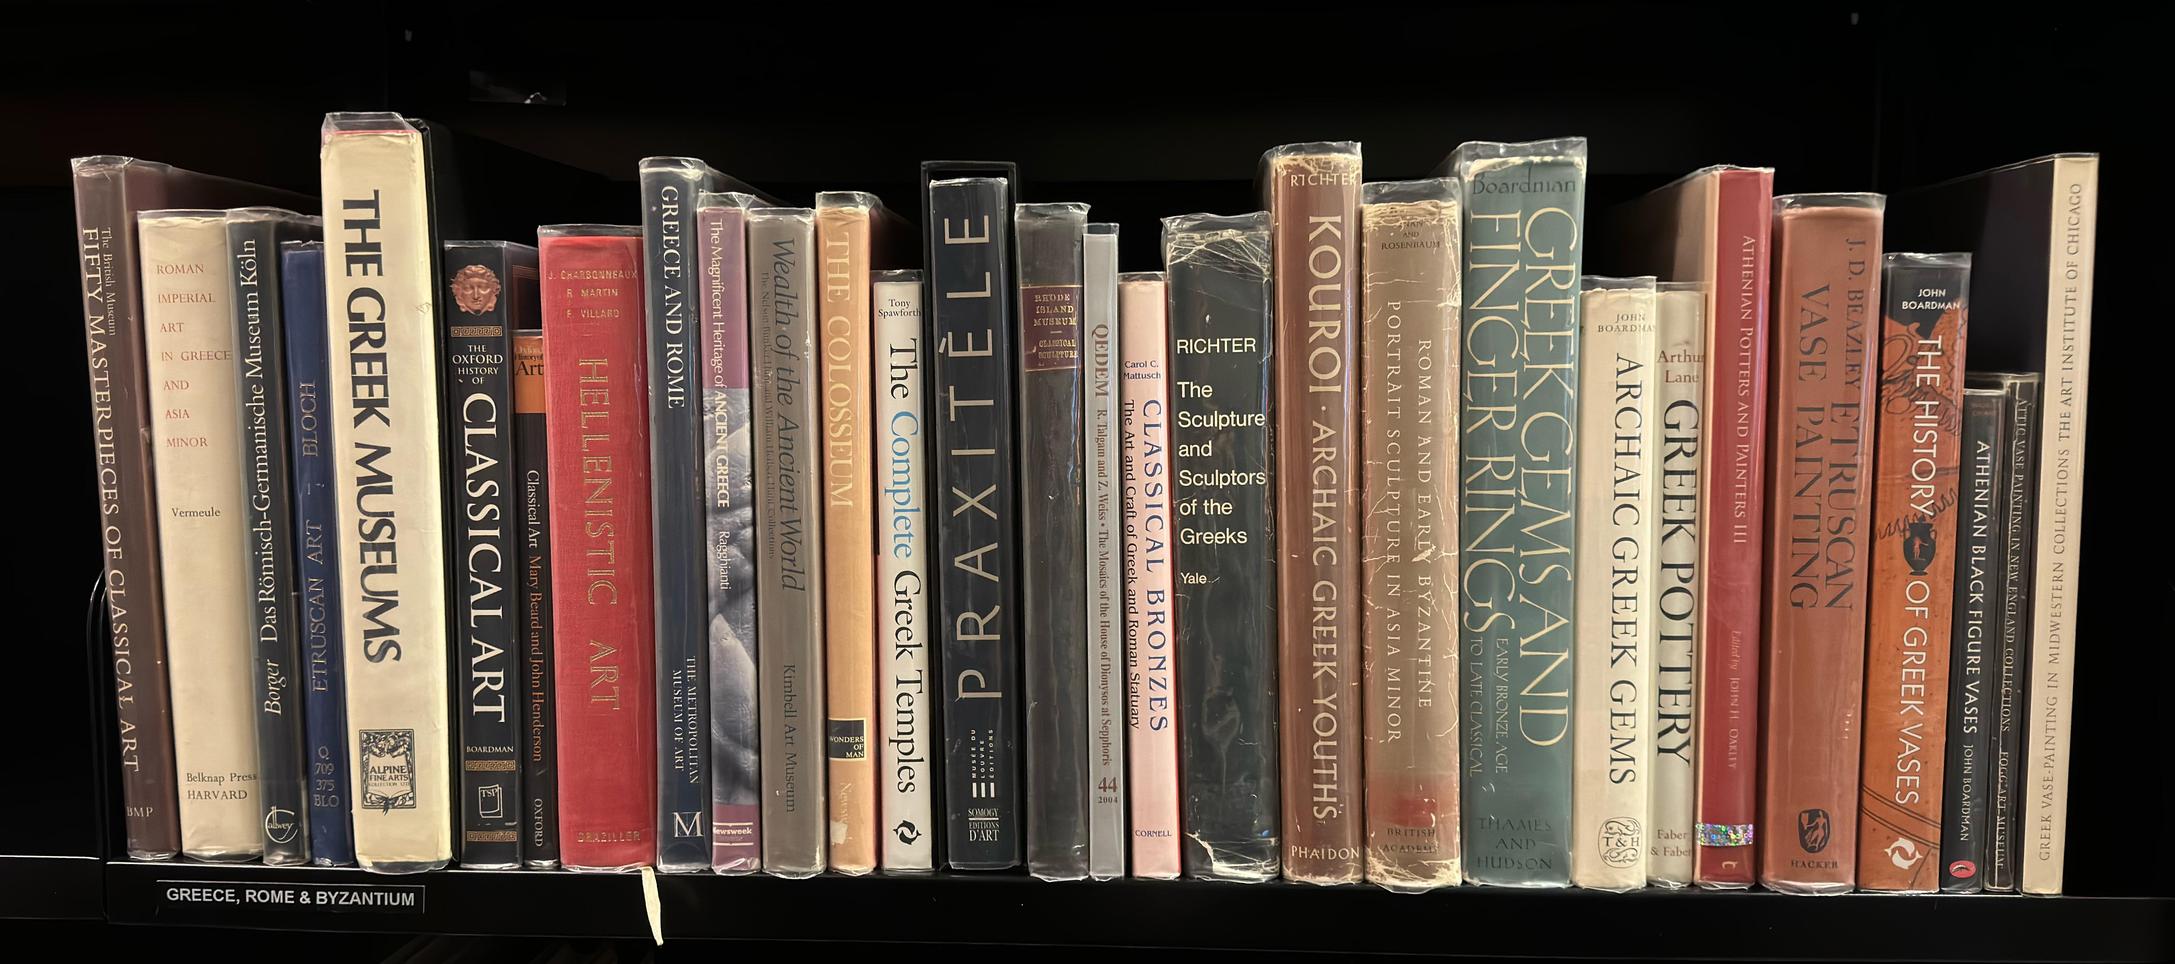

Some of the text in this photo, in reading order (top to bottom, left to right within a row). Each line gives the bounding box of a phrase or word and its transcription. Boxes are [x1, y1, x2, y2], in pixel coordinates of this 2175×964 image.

[156, 263, 205, 275] ROMAN
[158, 292, 216, 304] IMPERIAL
[661, 185, 685, 409] GREECE AND ROME
[1917, 288, 1946, 298] JOHN
[878, 308, 922, 319] Spawforth
[888, 298, 911, 309] Tony
[1308, 215, 1342, 393] KOUROI
[1901, 300, 1961, 310] BOARDMAN
[2059, 183, 2082, 442] THE ART INSTITUTE OF CHICAGO
[160, 322, 185, 333] ART
[161, 350, 232, 361] IN GREECE
[1176, 338, 1257, 354] RICHTER
[452, 354, 503, 365] OXFORD
[826, 231, 854, 508] THE COLOSSEUM
[458, 366, 499, 375] HISTORY
[1122, 371, 1162, 380] Mattusch
[1665, 369, 1700, 384] Lane
[163, 380, 189, 390] AND
[1177, 381, 1213, 399] The
[1733, 235, 1756, 544] ATHENIAN POTTERS AND PAINTERS III
[165, 409, 190, 419] ASIA
[299, 382, 319, 457] BLOCH
[771, 239, 806, 592] Wealth of the Ancient World
[1178, 410, 1266, 430] Sculpture
[1463, 209, 1522, 634] FINGER RINGS
[342, 189, 402, 664] THE GREEK MUSEUMS
[166, 438, 209, 448] MINOR
[1178, 440, 1213, 457] and
[1789, 283, 1831, 610] VASE PAINTING
[938, 214, 1003, 699] PRAXITÈLE
[236, 239, 288, 715] Borger Das Römisch-Germanische Museum Köln
[1179, 469, 1266, 488] Sculptors
[1517, 207, 1578, 747] GREEK GEMS AND
[83, 227, 140, 772] FIFTY MASTERPIECES OF CLASSICAL ART
[1179, 498, 1233, 516] of the
[1824, 402, 1860, 612] ETRUSCAN
[172, 507, 221, 518] Vermeule
[1386, 300, 1402, 743] PORTRAIT SCULPTURE IN ASIA MINOR
[1417, 339, 1433, 708] ROMAN AND EARLY BYZANTINE
[578, 358, 620, 711] HELLENISTIC ART
[1180, 527, 1248, 545] Greeks
[463, 392, 506, 723] CLASSICAL ART
[884, 337, 925, 795] The Complete Greek Temples
[1124, 399, 1141, 730] The Art and Craft of Greek and Roman Statuary
[1142, 399, 1168, 731] CLASSICAL BRONZES
[1180, 572, 1207, 585] Yale
[1609, 352, 1644, 785] ARCHAIC GREEK GEMS
[1895, 334, 1942, 805] THE HISTORY OF GREEK VASES
[1657, 399, 1700, 768] GREEK POTTERY
[1963, 440, 1991, 734] ATHENIAN BLACK FIGURE VASES
[306, 519, 328, 692] ETRUSCAN ART
[526, 470, 545, 762] Classical Art Mary Beard and John Henderson
[1312, 420, 1338, 820] ARCHAIC GREEK YOUTHS
[2039, 449, 2070, 862] GREEK VASE-PAINTING IN MIDWESTERN COLLECTIONS
[783, 664, 798, 813] Kimbell Art Museum
[186, 772, 257, 786] Belknap Press
[369, 765, 407, 775] ALPINE
[187, 789, 248, 800] HARVARD
[1098, 776, 1118, 793] 44
[1960, 744, 1974, 841] JOHN BOARDMAN
[313, 794, 340, 808] BLO
[967, 807, 998, 817] SOMOGY
[534, 798, 545, 848] OXFORD
[1657, 828, 1687, 840] Faber
[1290, 845, 1360, 860] PHAIDON
[1477, 855, 1553, 870] HUDSON
[166, 887, 416, 906] GREECE, ROME & BYZANTIUM
